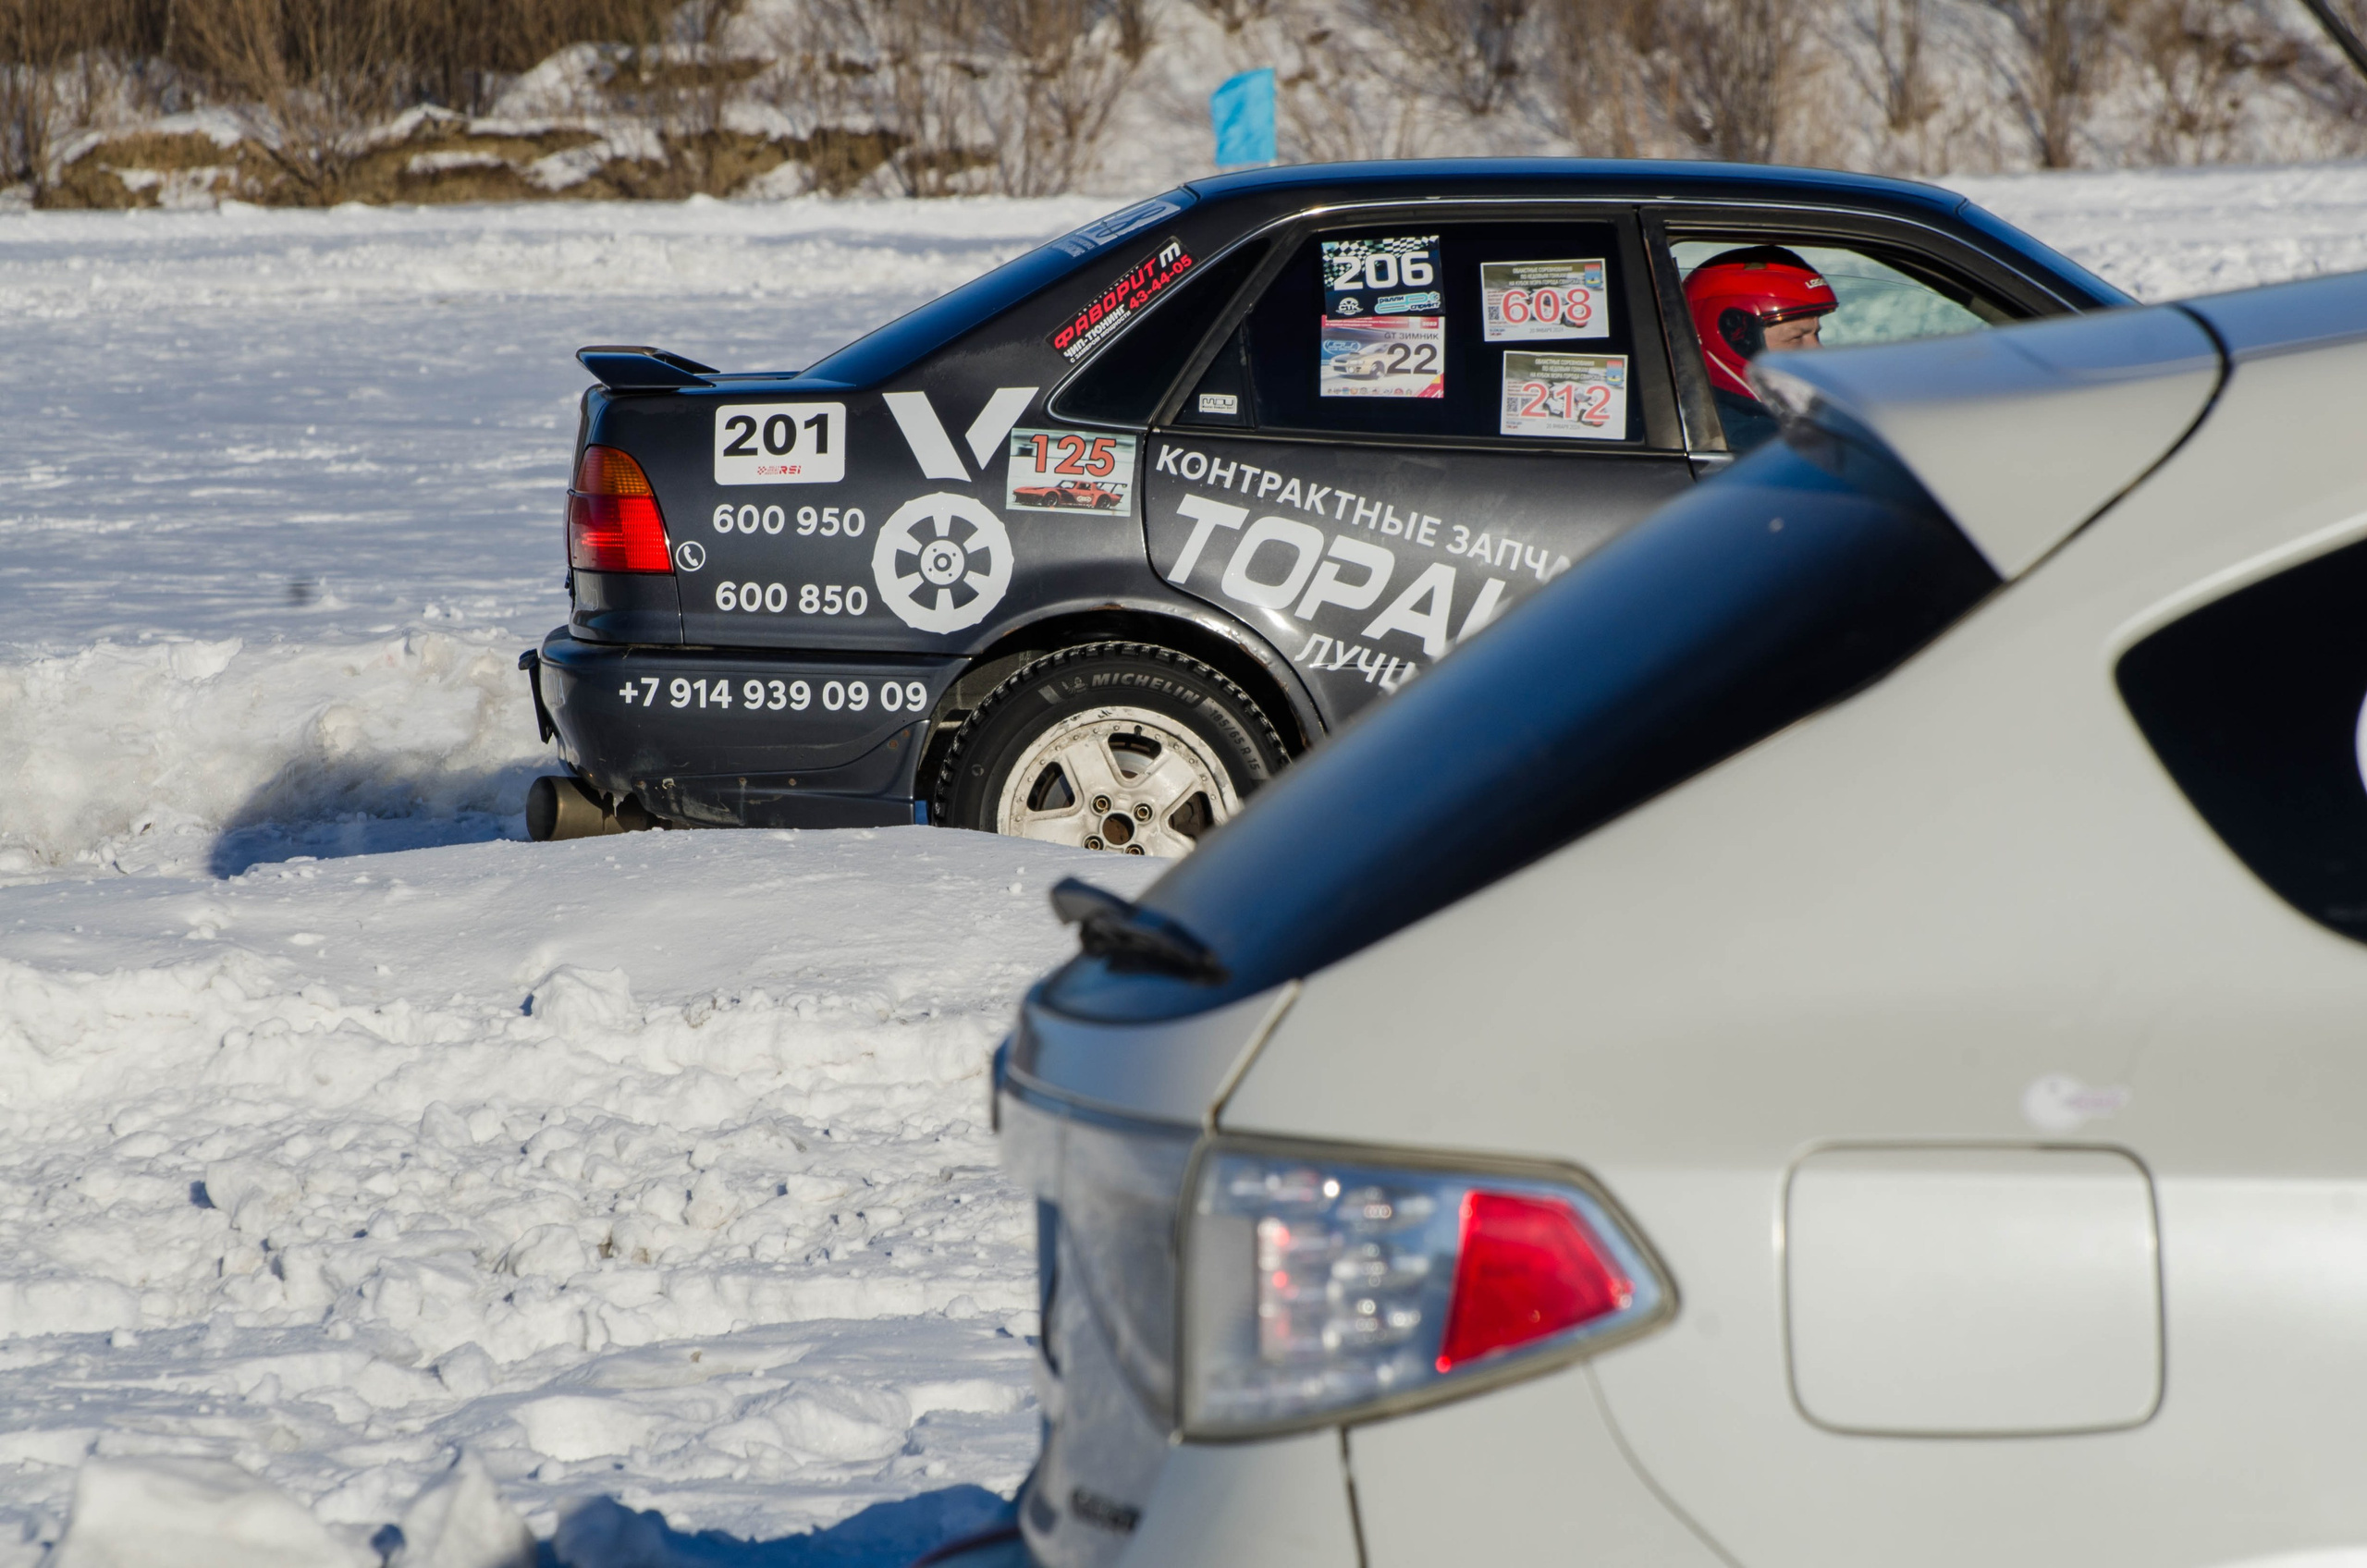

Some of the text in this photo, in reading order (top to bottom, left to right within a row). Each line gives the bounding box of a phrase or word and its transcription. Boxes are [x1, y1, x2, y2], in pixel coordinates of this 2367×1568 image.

[1129, 254, 1193, 310] 43-44-05
[1332, 251, 1434, 291] 206
[1502, 288, 1592, 324] 608
[1063, 303, 1125, 358] ЧИП-ТЮНИНГ
[1399, 332, 1439, 340] ЗИМНИК
[1387, 342, 1438, 374] 22
[1521, 383, 1612, 420] 212
[723, 412, 828, 457] 201
[1030, 434, 1116, 477] 125
[1156, 444, 1441, 547] КОНТРАКТНЫЕ
[713, 504, 865, 537] 600 950
[716, 581, 868, 616] 600 850
[619, 677, 928, 712] +7 914 939 09 09
[1092, 672, 1200, 704] MICHELIN
[1208, 708, 1261, 771] 185/65 R 15
